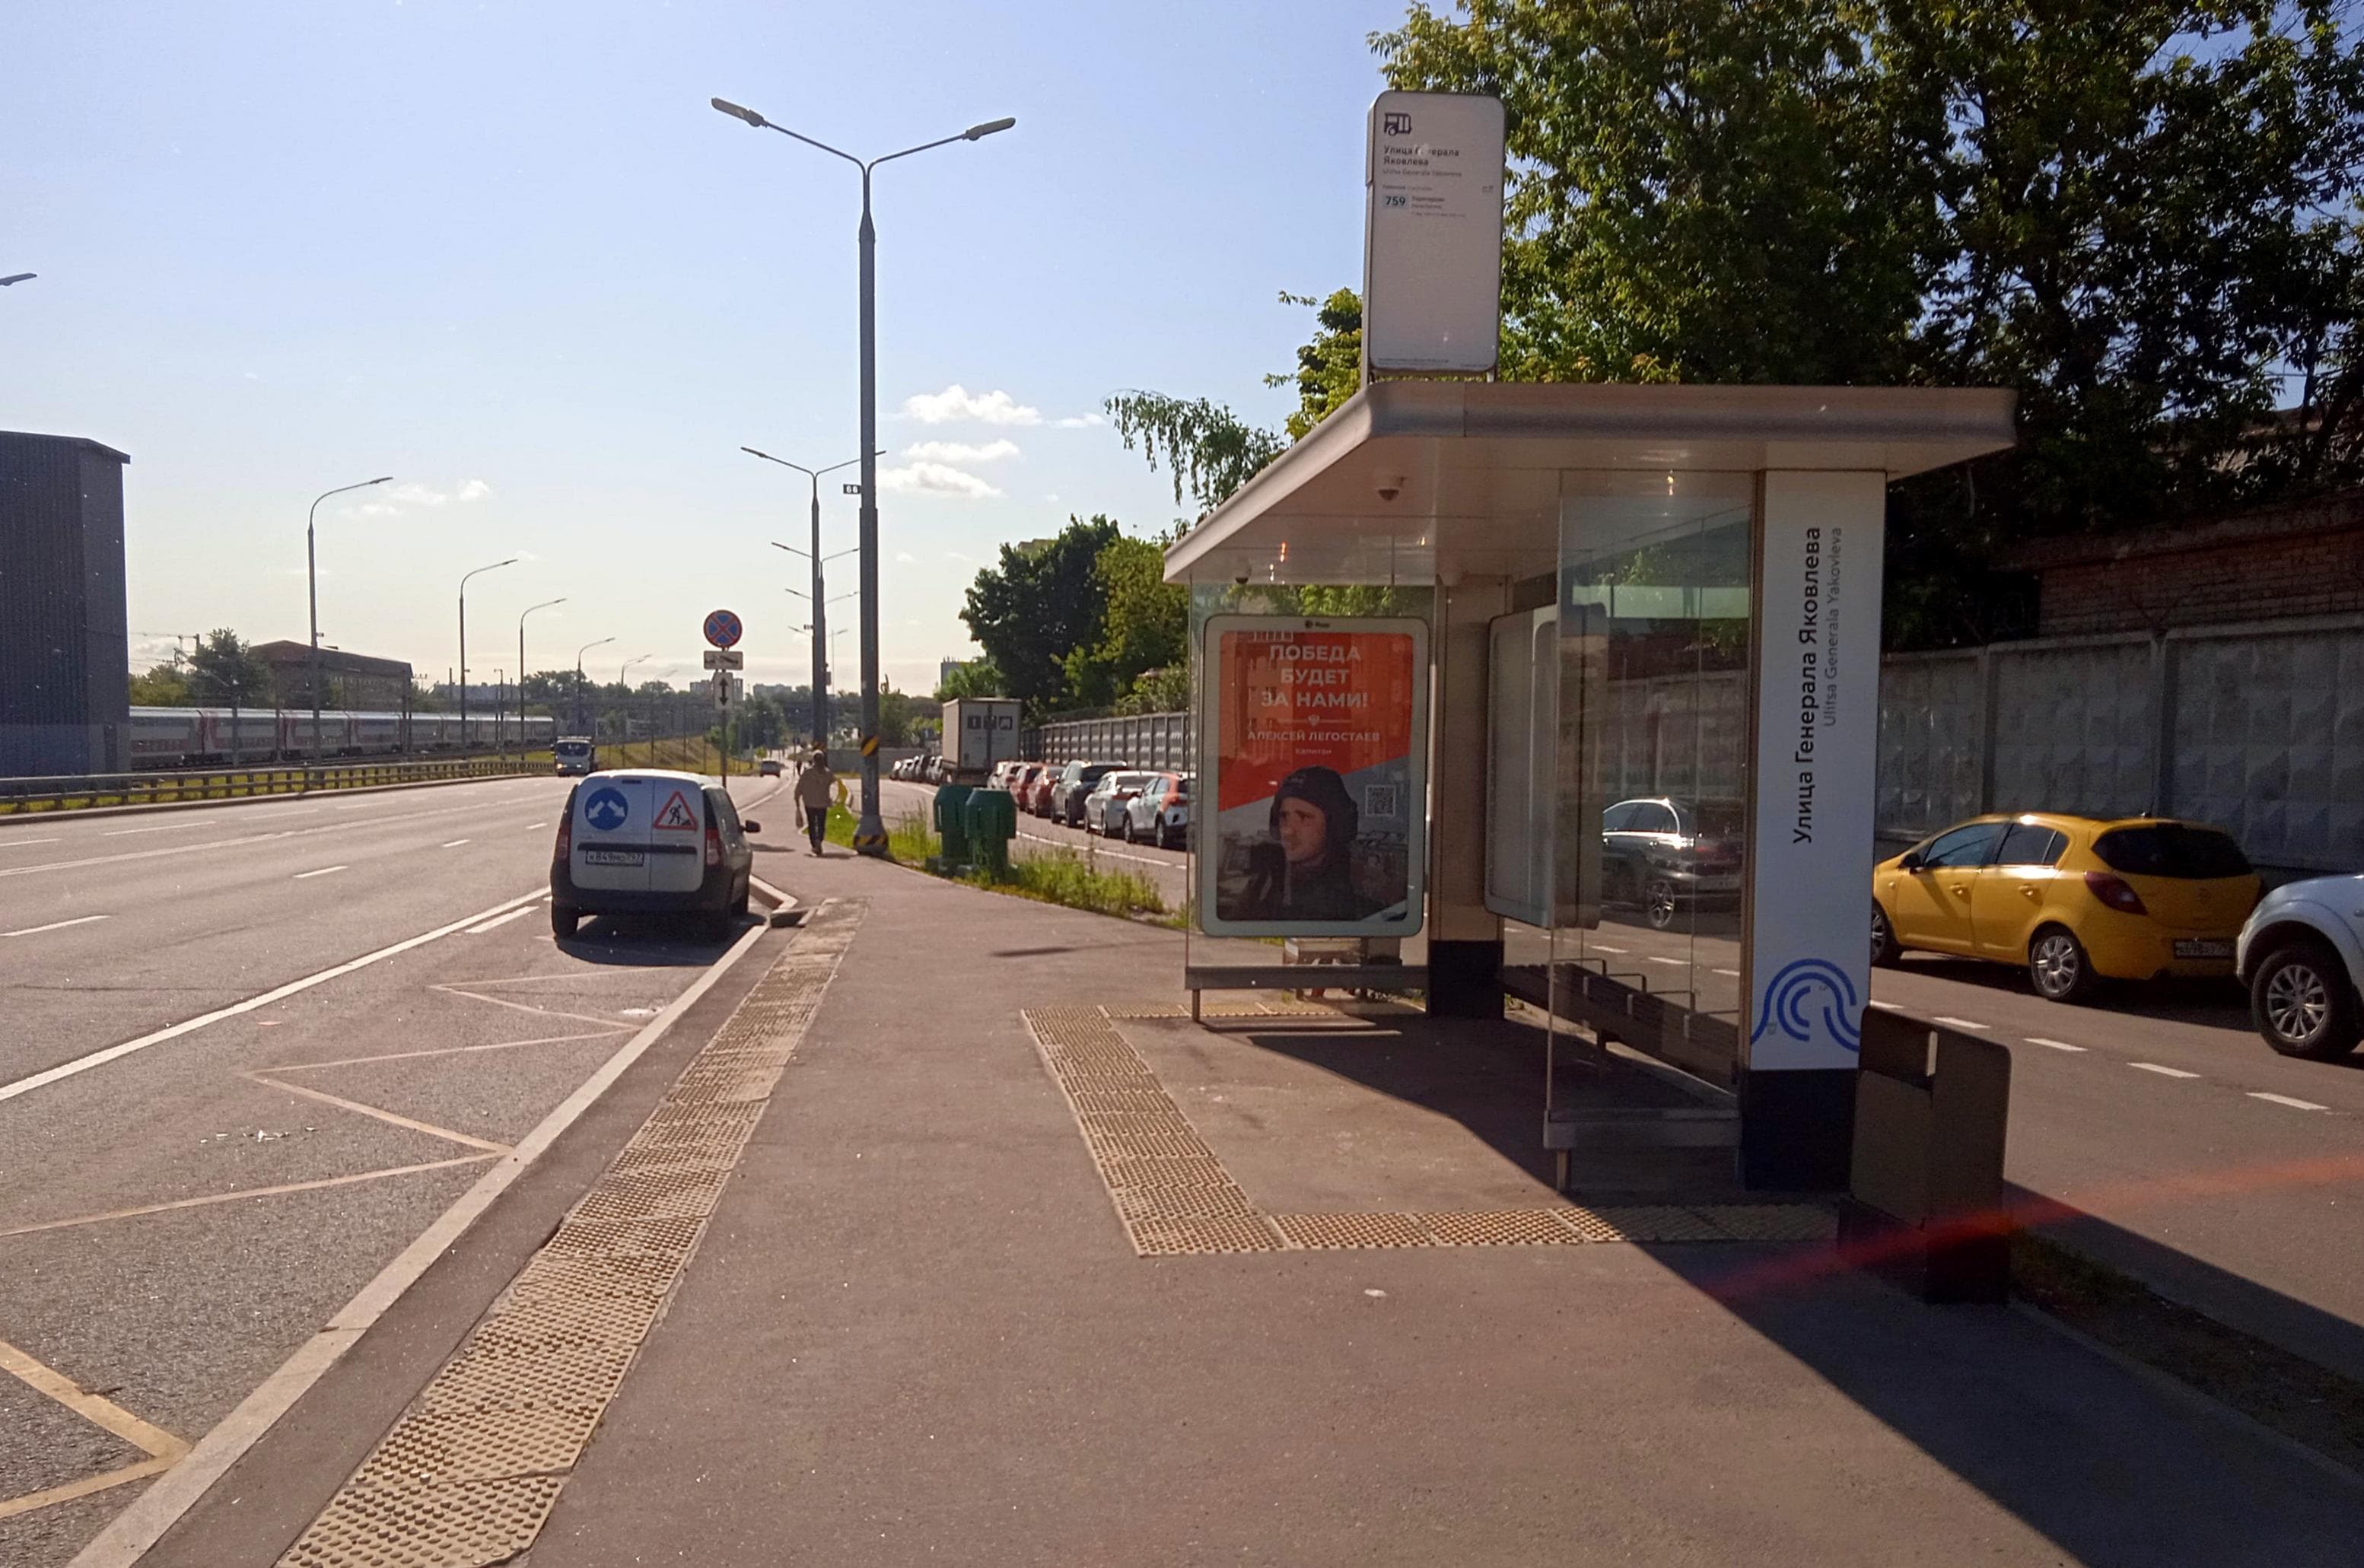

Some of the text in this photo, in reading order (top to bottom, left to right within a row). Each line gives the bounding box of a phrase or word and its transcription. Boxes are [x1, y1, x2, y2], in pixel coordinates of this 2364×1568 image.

[1383, 145, 1413, 156] Улица
[1383, 155, 1429, 166] Яковлева
[1386, 196, 1406, 206] 759
[1824, 526, 1842, 727] Ulitsa Generala Yakovleva
[1269, 644, 1361, 663] ПОБЕДА
[1281, 668, 1350, 686] БУДЕТ
[1793, 526, 1821, 844] Улица Генерала Яковлева
[1261, 691, 1369, 708] ЗА НАМИ!
[1247, 730, 1380, 743] АЛЕКСЕЙ ЛЕГОСТАЕВ
